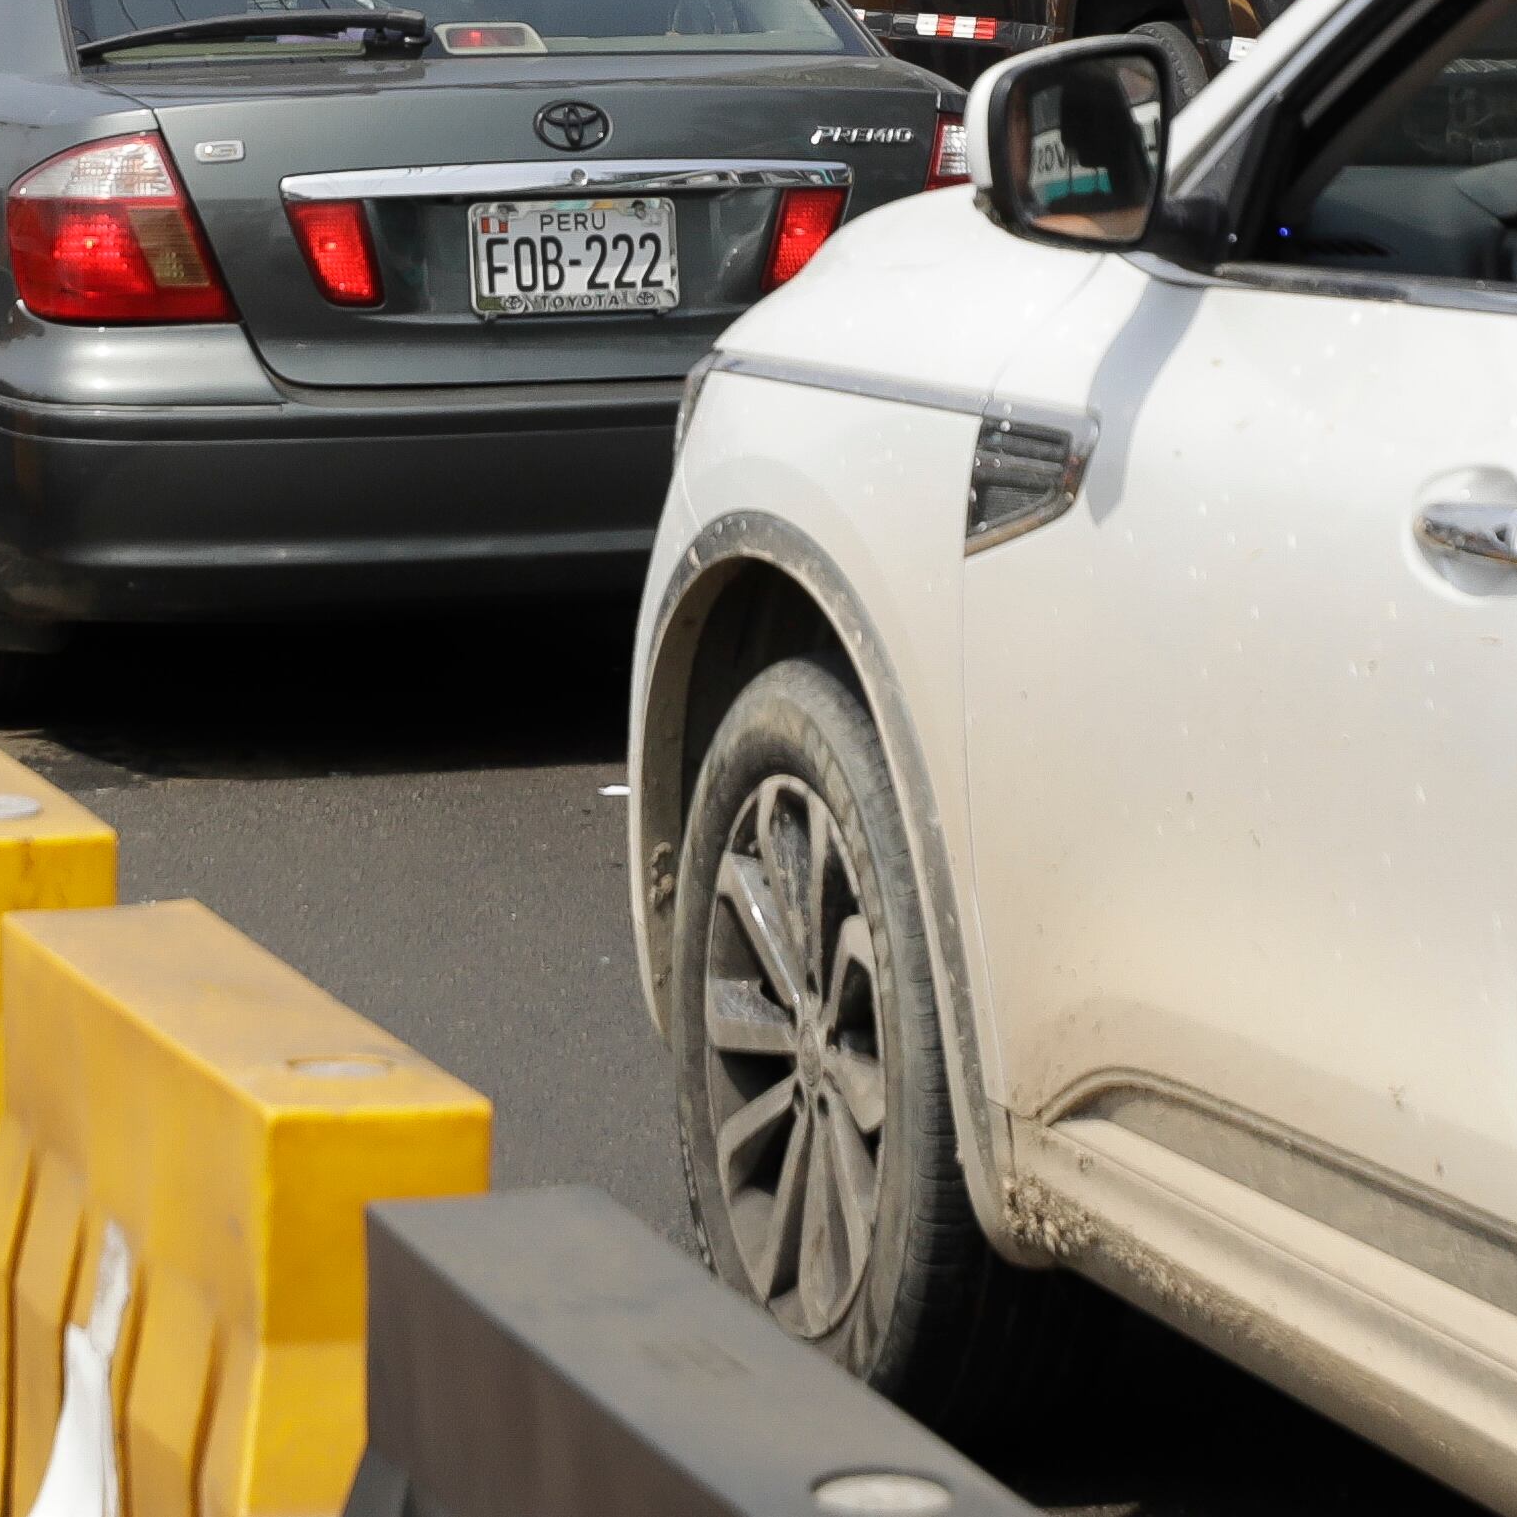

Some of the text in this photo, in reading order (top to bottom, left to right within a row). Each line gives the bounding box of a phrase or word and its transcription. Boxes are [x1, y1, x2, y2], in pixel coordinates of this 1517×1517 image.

[810, 126, 915, 145] PREMIO
[540, 212, 606, 232] PERU
[540, 294, 620, 308] TOYOTA
